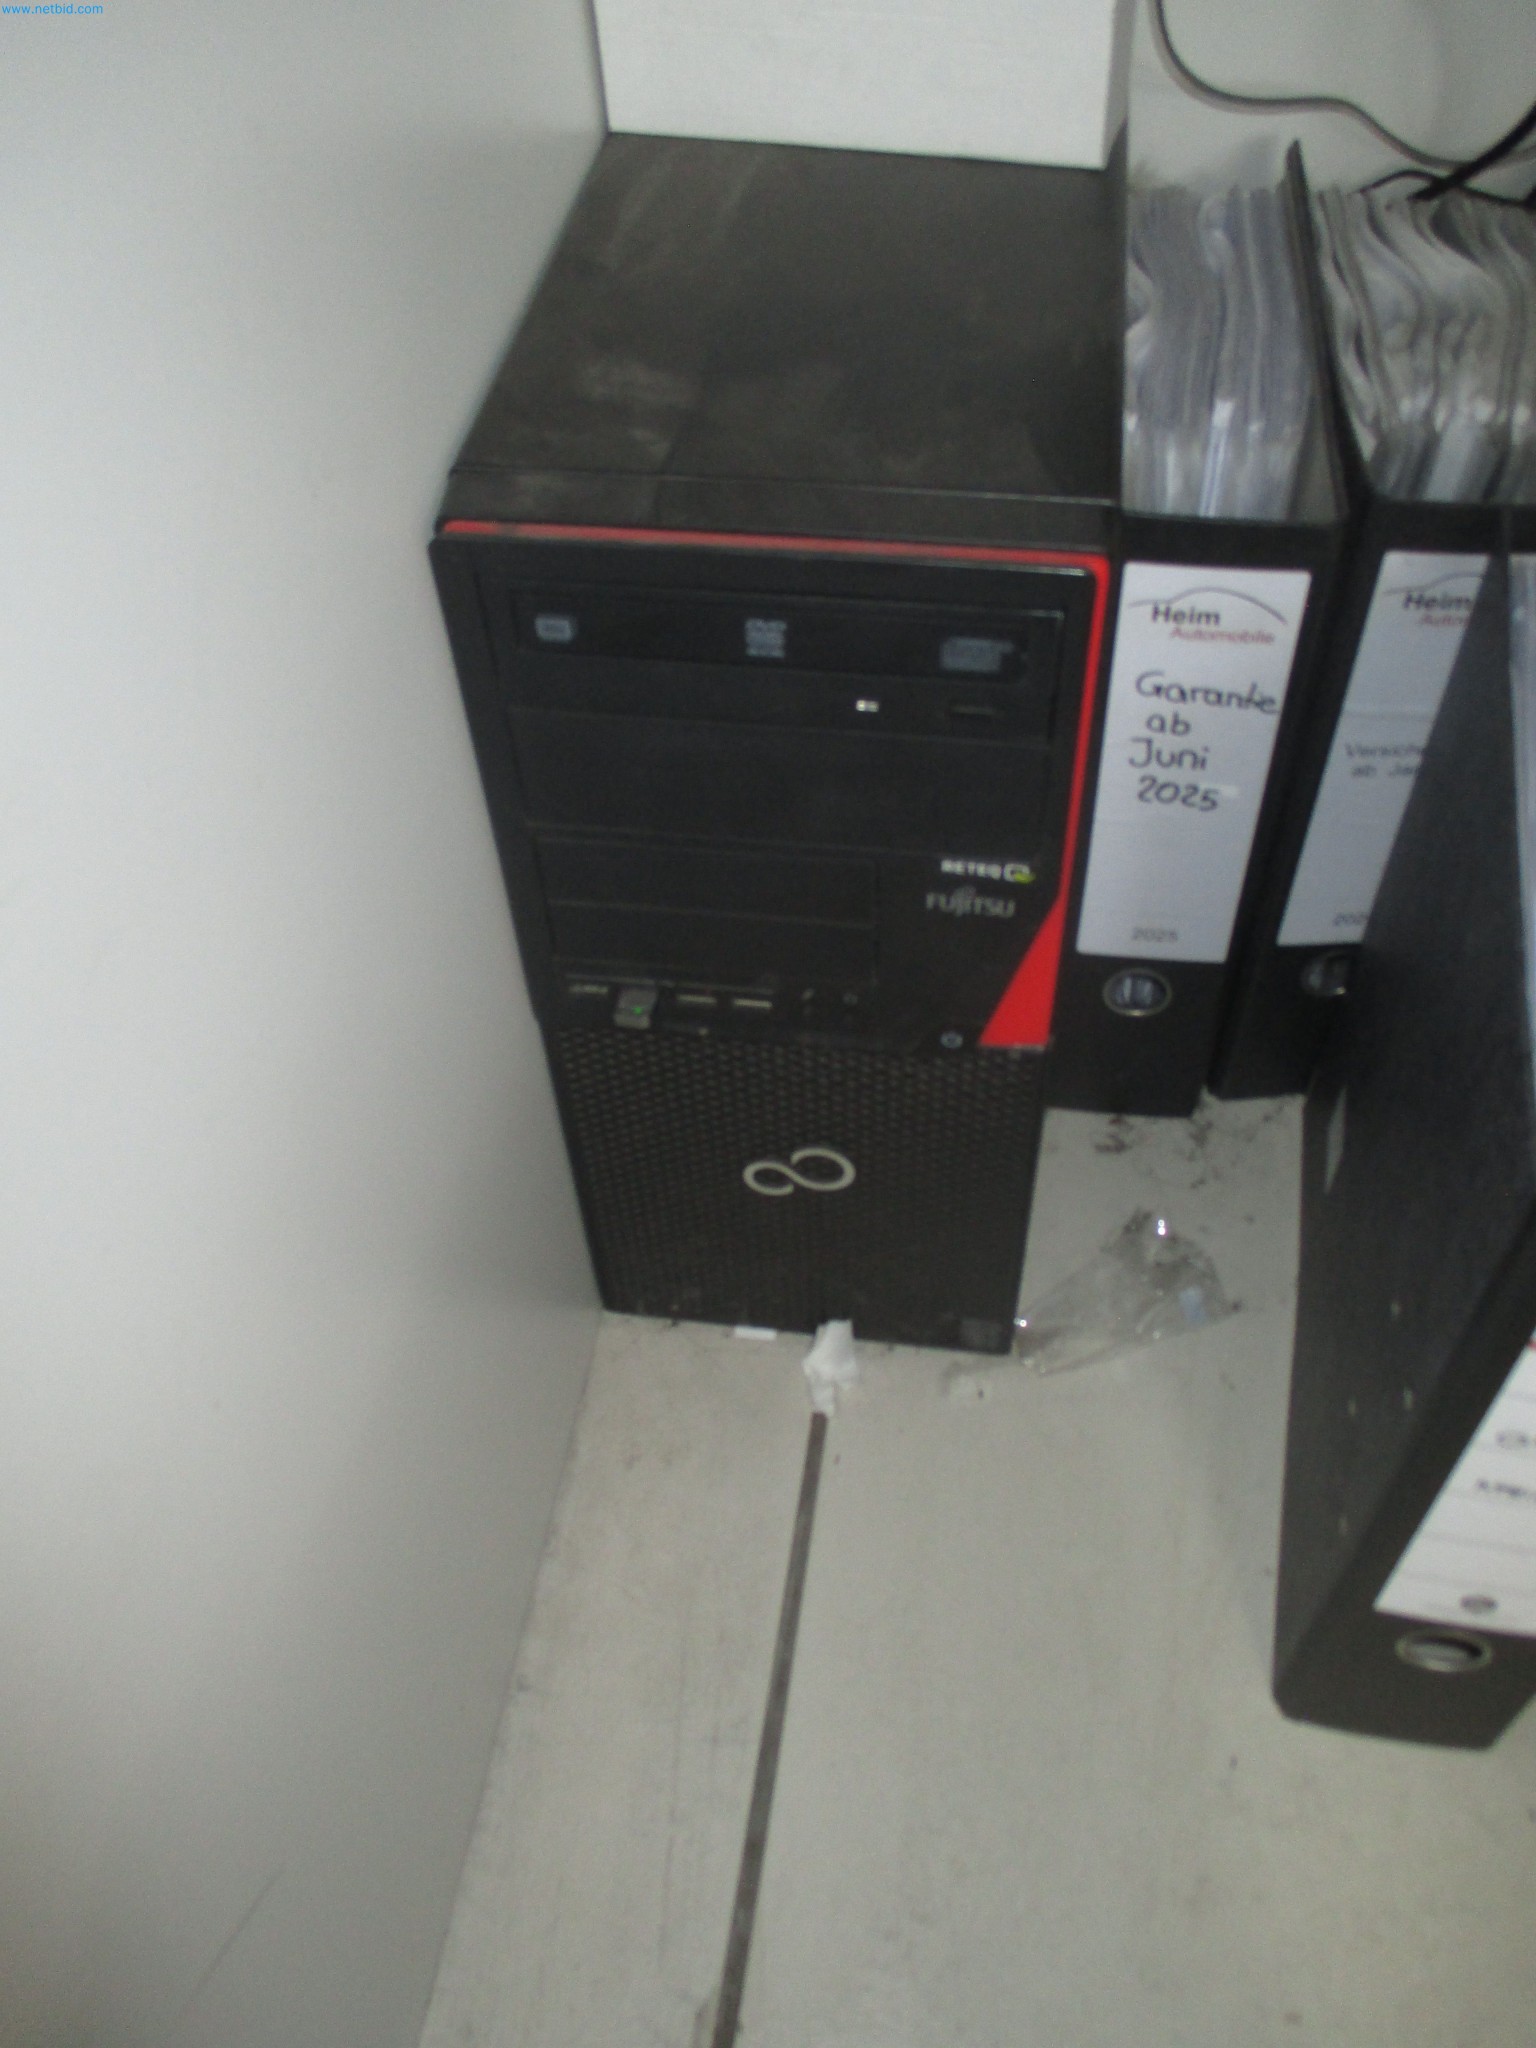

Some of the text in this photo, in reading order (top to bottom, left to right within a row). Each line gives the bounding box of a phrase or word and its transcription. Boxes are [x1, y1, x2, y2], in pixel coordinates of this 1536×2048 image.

[1151, 602, 1221, 625] Heim
[1170, 626, 1276, 645] Automobile
[1145, 710, 1192, 737] ab
[1128, 736, 1210, 772] Juni
[1136, 773, 1220, 813] 2025
[925, 892, 1016, 918] FUJITSU
